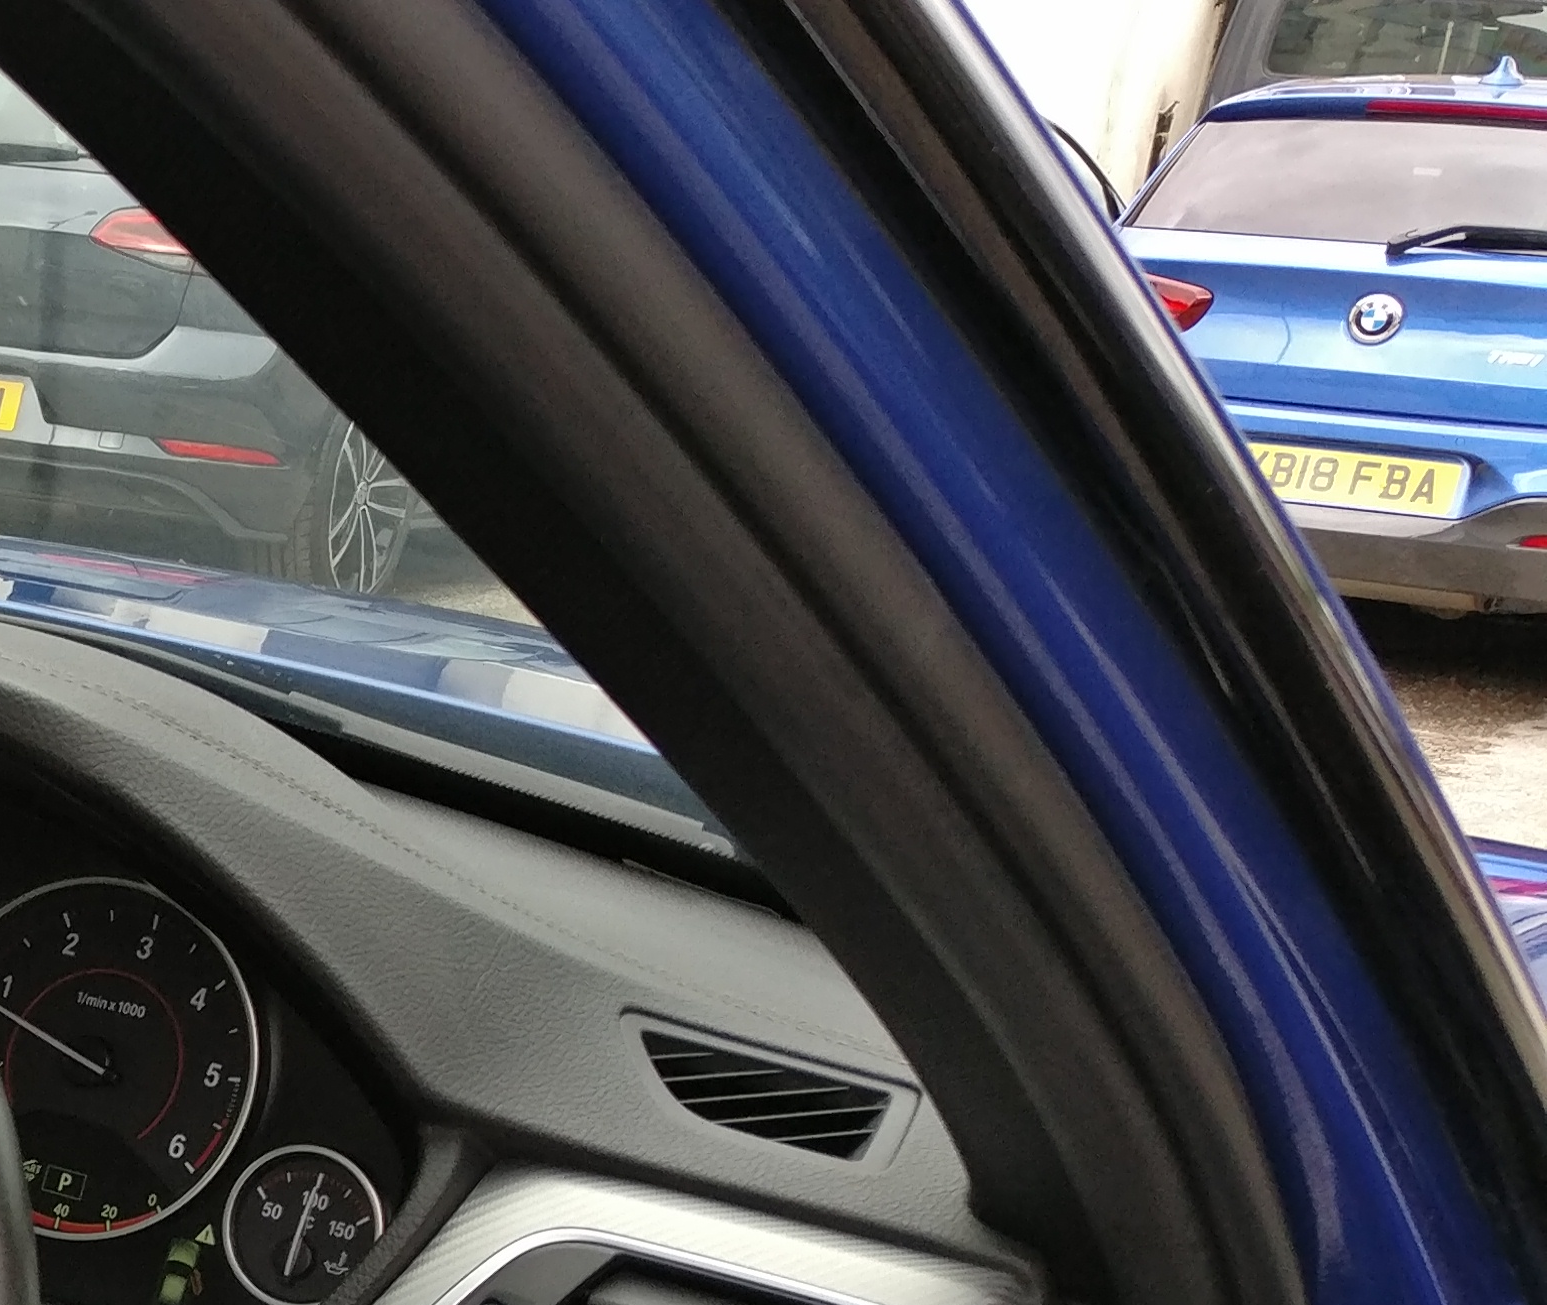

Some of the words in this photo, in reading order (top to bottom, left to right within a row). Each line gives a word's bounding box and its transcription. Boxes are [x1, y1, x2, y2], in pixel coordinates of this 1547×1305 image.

[1348, 460, 1435, 504] FBA
[61, 933, 80, 957] 2
[136, 936, 154, 960] 3
[2, 975, 14, 998] 1
[76, 991, 108, 1010] 1/min
[117, 1000, 146, 1019] 1000
[189, 987, 208, 1011] 4
[203, 1062, 222, 1087] 5
[168, 1133, 187, 1158] 6
[58, 1172, 73, 1192] P
[53, 1203, 70, 1217] 40
[101, 1204, 118, 1219] 20
[147, 1193, 157, 1207] 0
[261, 1201, 283, 1220] 50
[328, 1220, 356, 1241] 150
